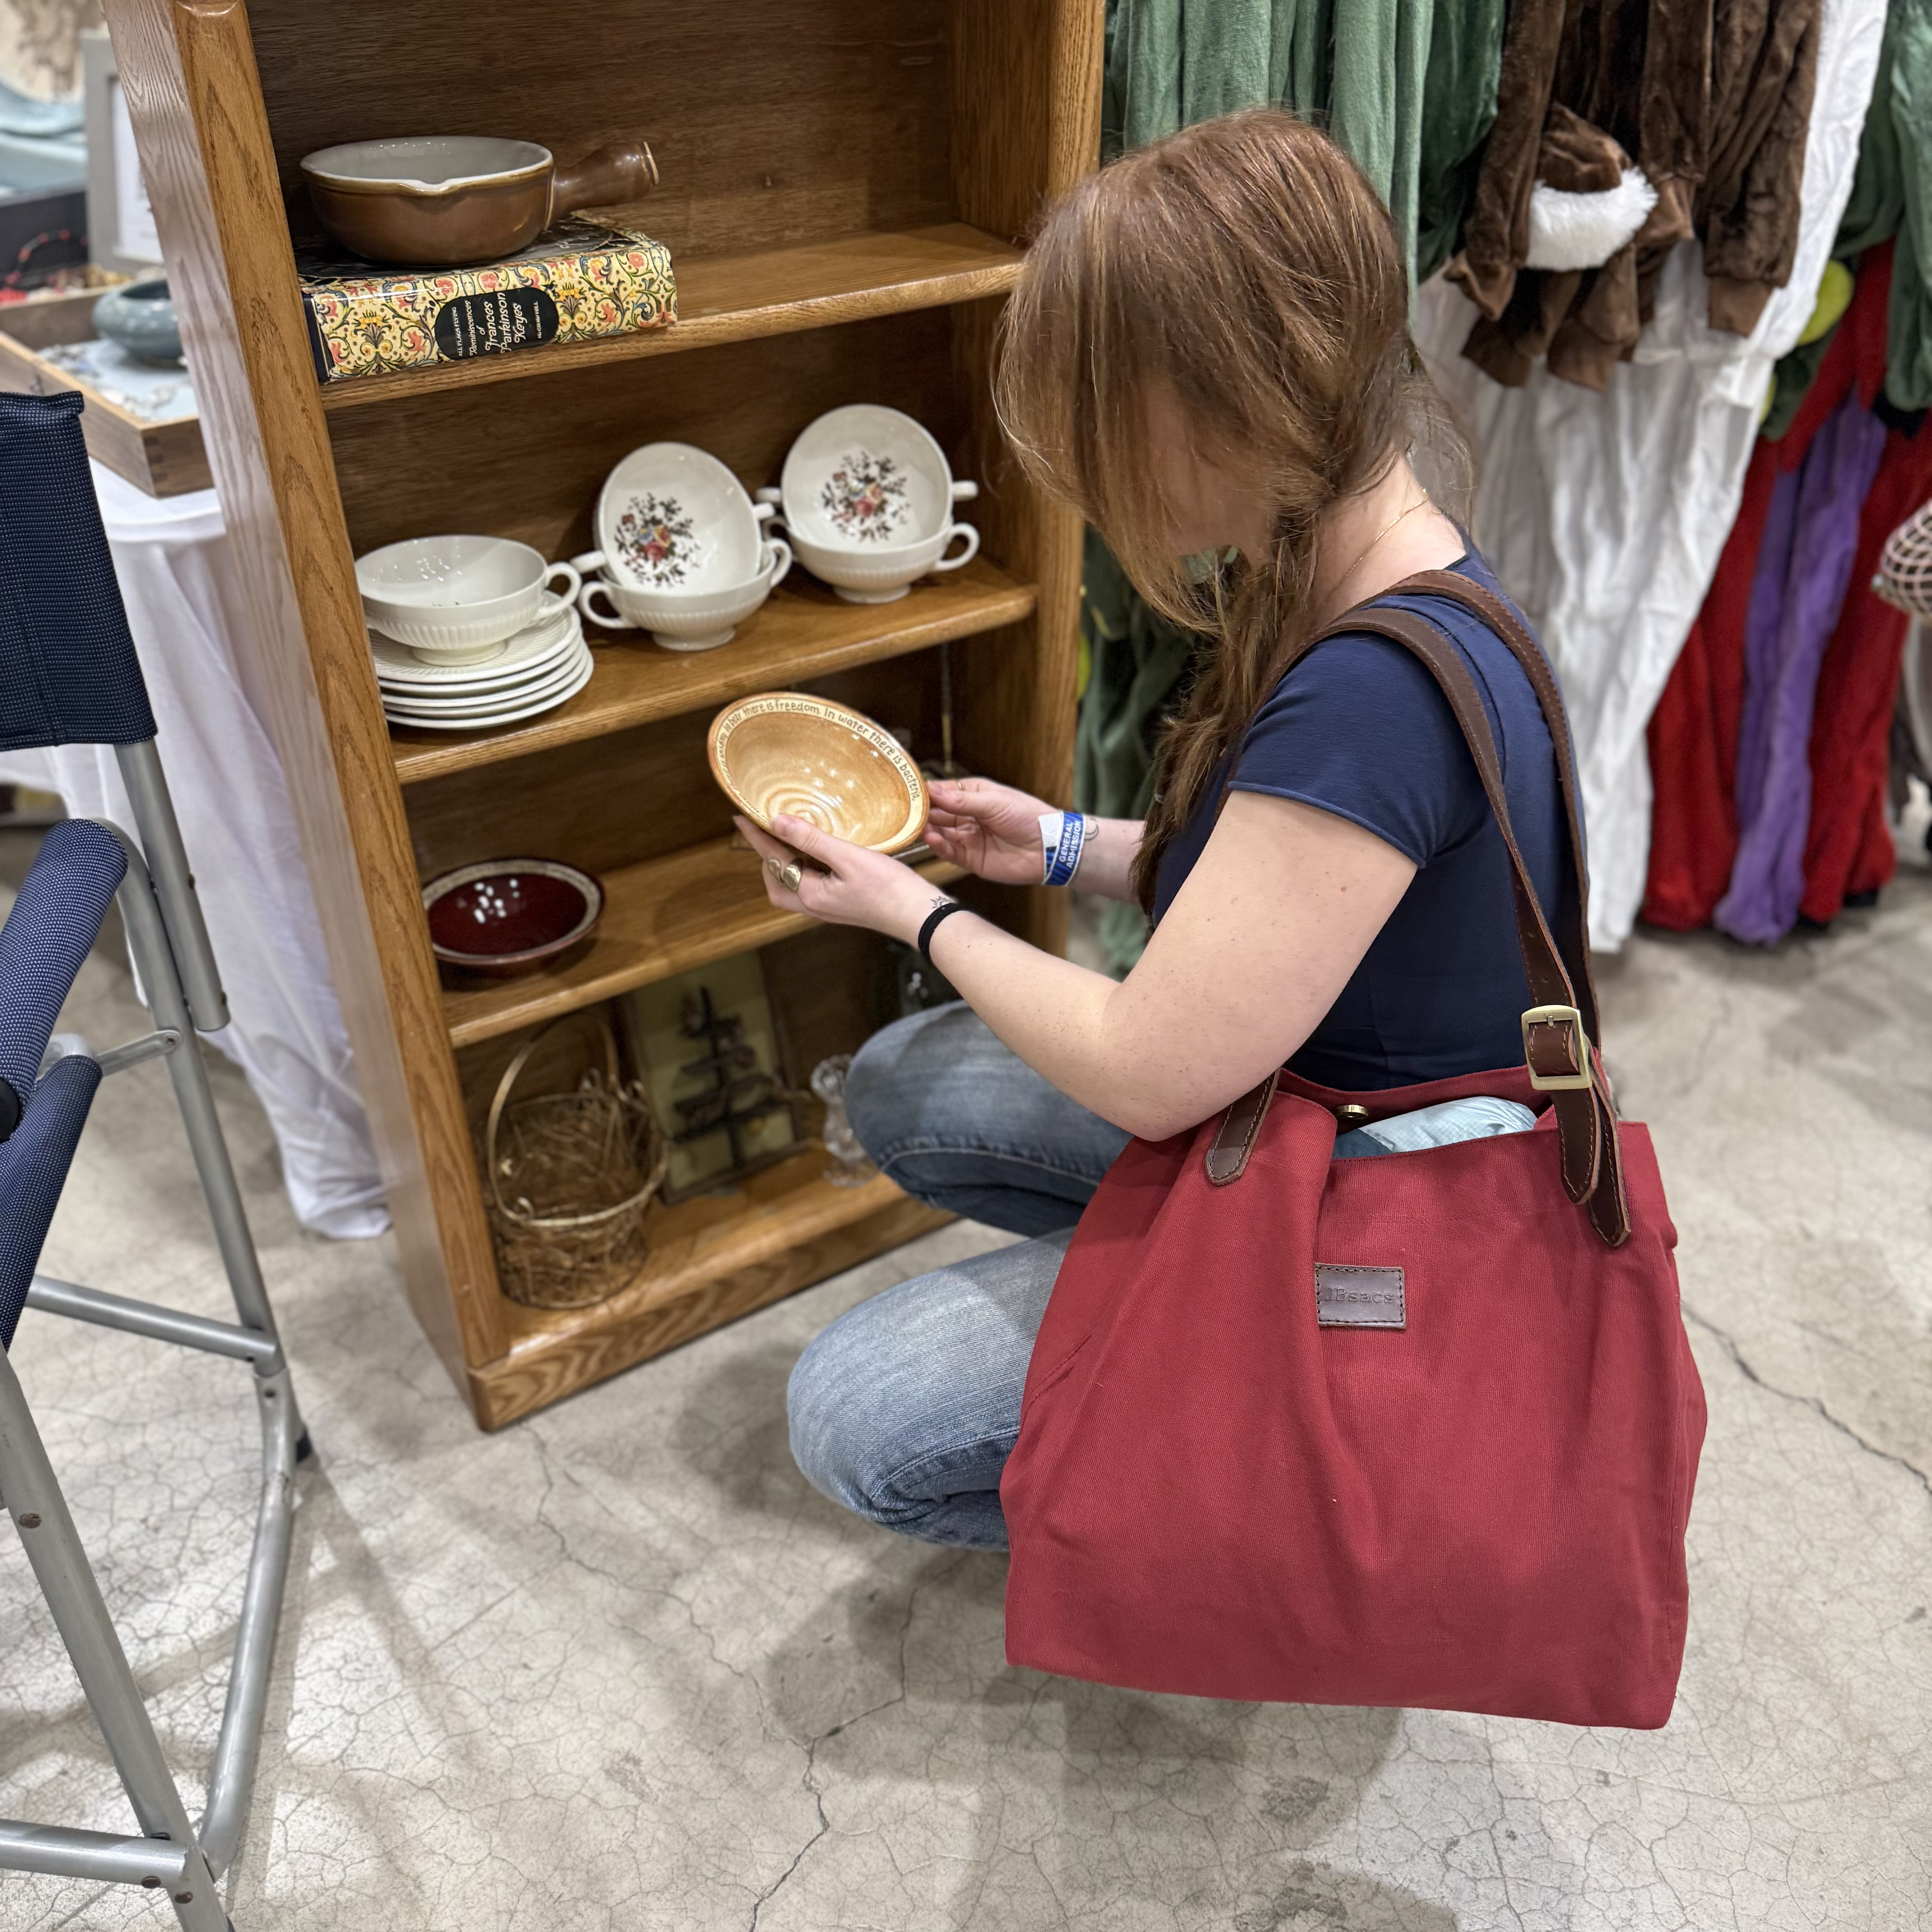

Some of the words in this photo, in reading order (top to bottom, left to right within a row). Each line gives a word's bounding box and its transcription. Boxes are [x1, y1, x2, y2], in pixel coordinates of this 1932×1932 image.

[451, 306, 459, 327] FLYING
[465, 300, 477, 356] Reminiscences
[476, 325, 486, 336] of
[484, 301, 501, 351] Frances
[498, 292, 513, 354] Parkinson
[513, 302, 527, 344] Keyes
[742, 703, 766, 717] there
[766, 701, 774, 711] is
[775, 700, 821, 715] freedom.
[824, 707, 835, 719] In
[838, 714, 869, 735] water
[869, 732, 896, 756] there
[893, 755, 903, 764] is
[899, 763, 920, 801] bacteria.
[1059, 822, 1073, 862] GENERAL
[1066, 820, 1082, 868] ADMISSION
